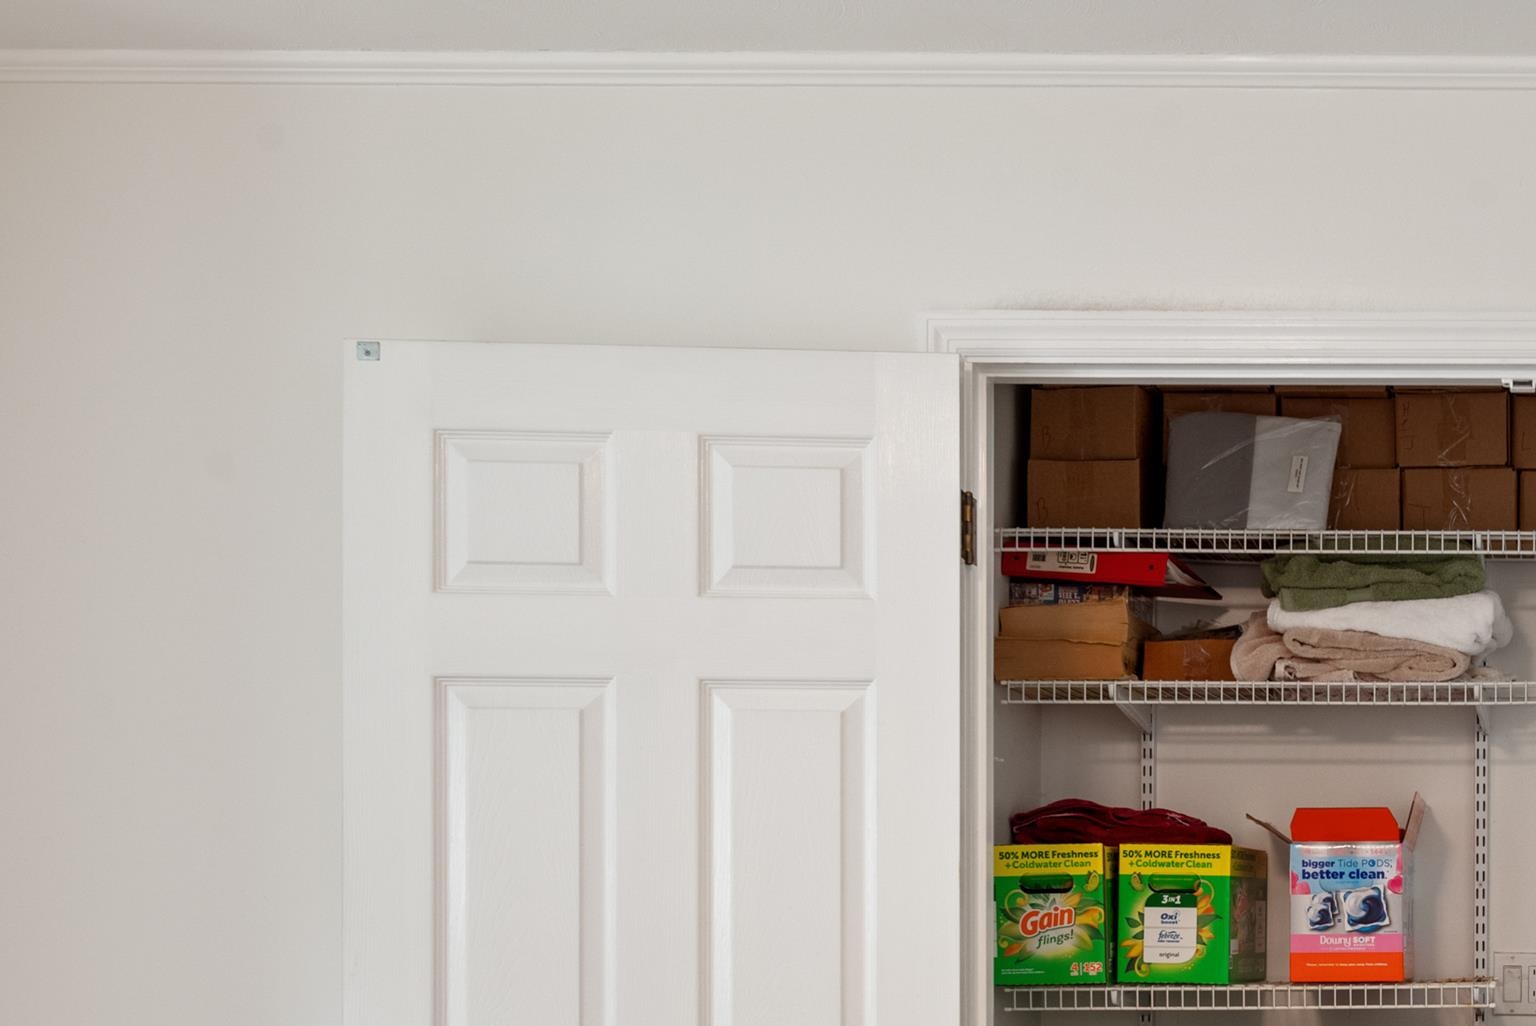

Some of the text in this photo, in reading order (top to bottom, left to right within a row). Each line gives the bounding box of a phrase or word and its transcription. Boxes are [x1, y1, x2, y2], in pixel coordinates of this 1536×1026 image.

[999, 850, 1099, 860] 50% MORE Freshness
[1122, 850, 1221, 860] 50% MORE Freshness
[1064, 859, 1092, 868] Clean
[1186, 860, 1213, 869] Clean
[1301, 859, 1335, 869] bigger
[1338, 859, 1358, 868] Tide
[1302, 869, 1345, 880] better
[1160, 912, 1178, 920] Oxi
[1019, 905, 1076, 938] Gain
[1036, 929, 1074, 949] flings!
[1320, 935, 1376, 947] Downy SOFT
[1070, 962, 1103, 973] 4 152
